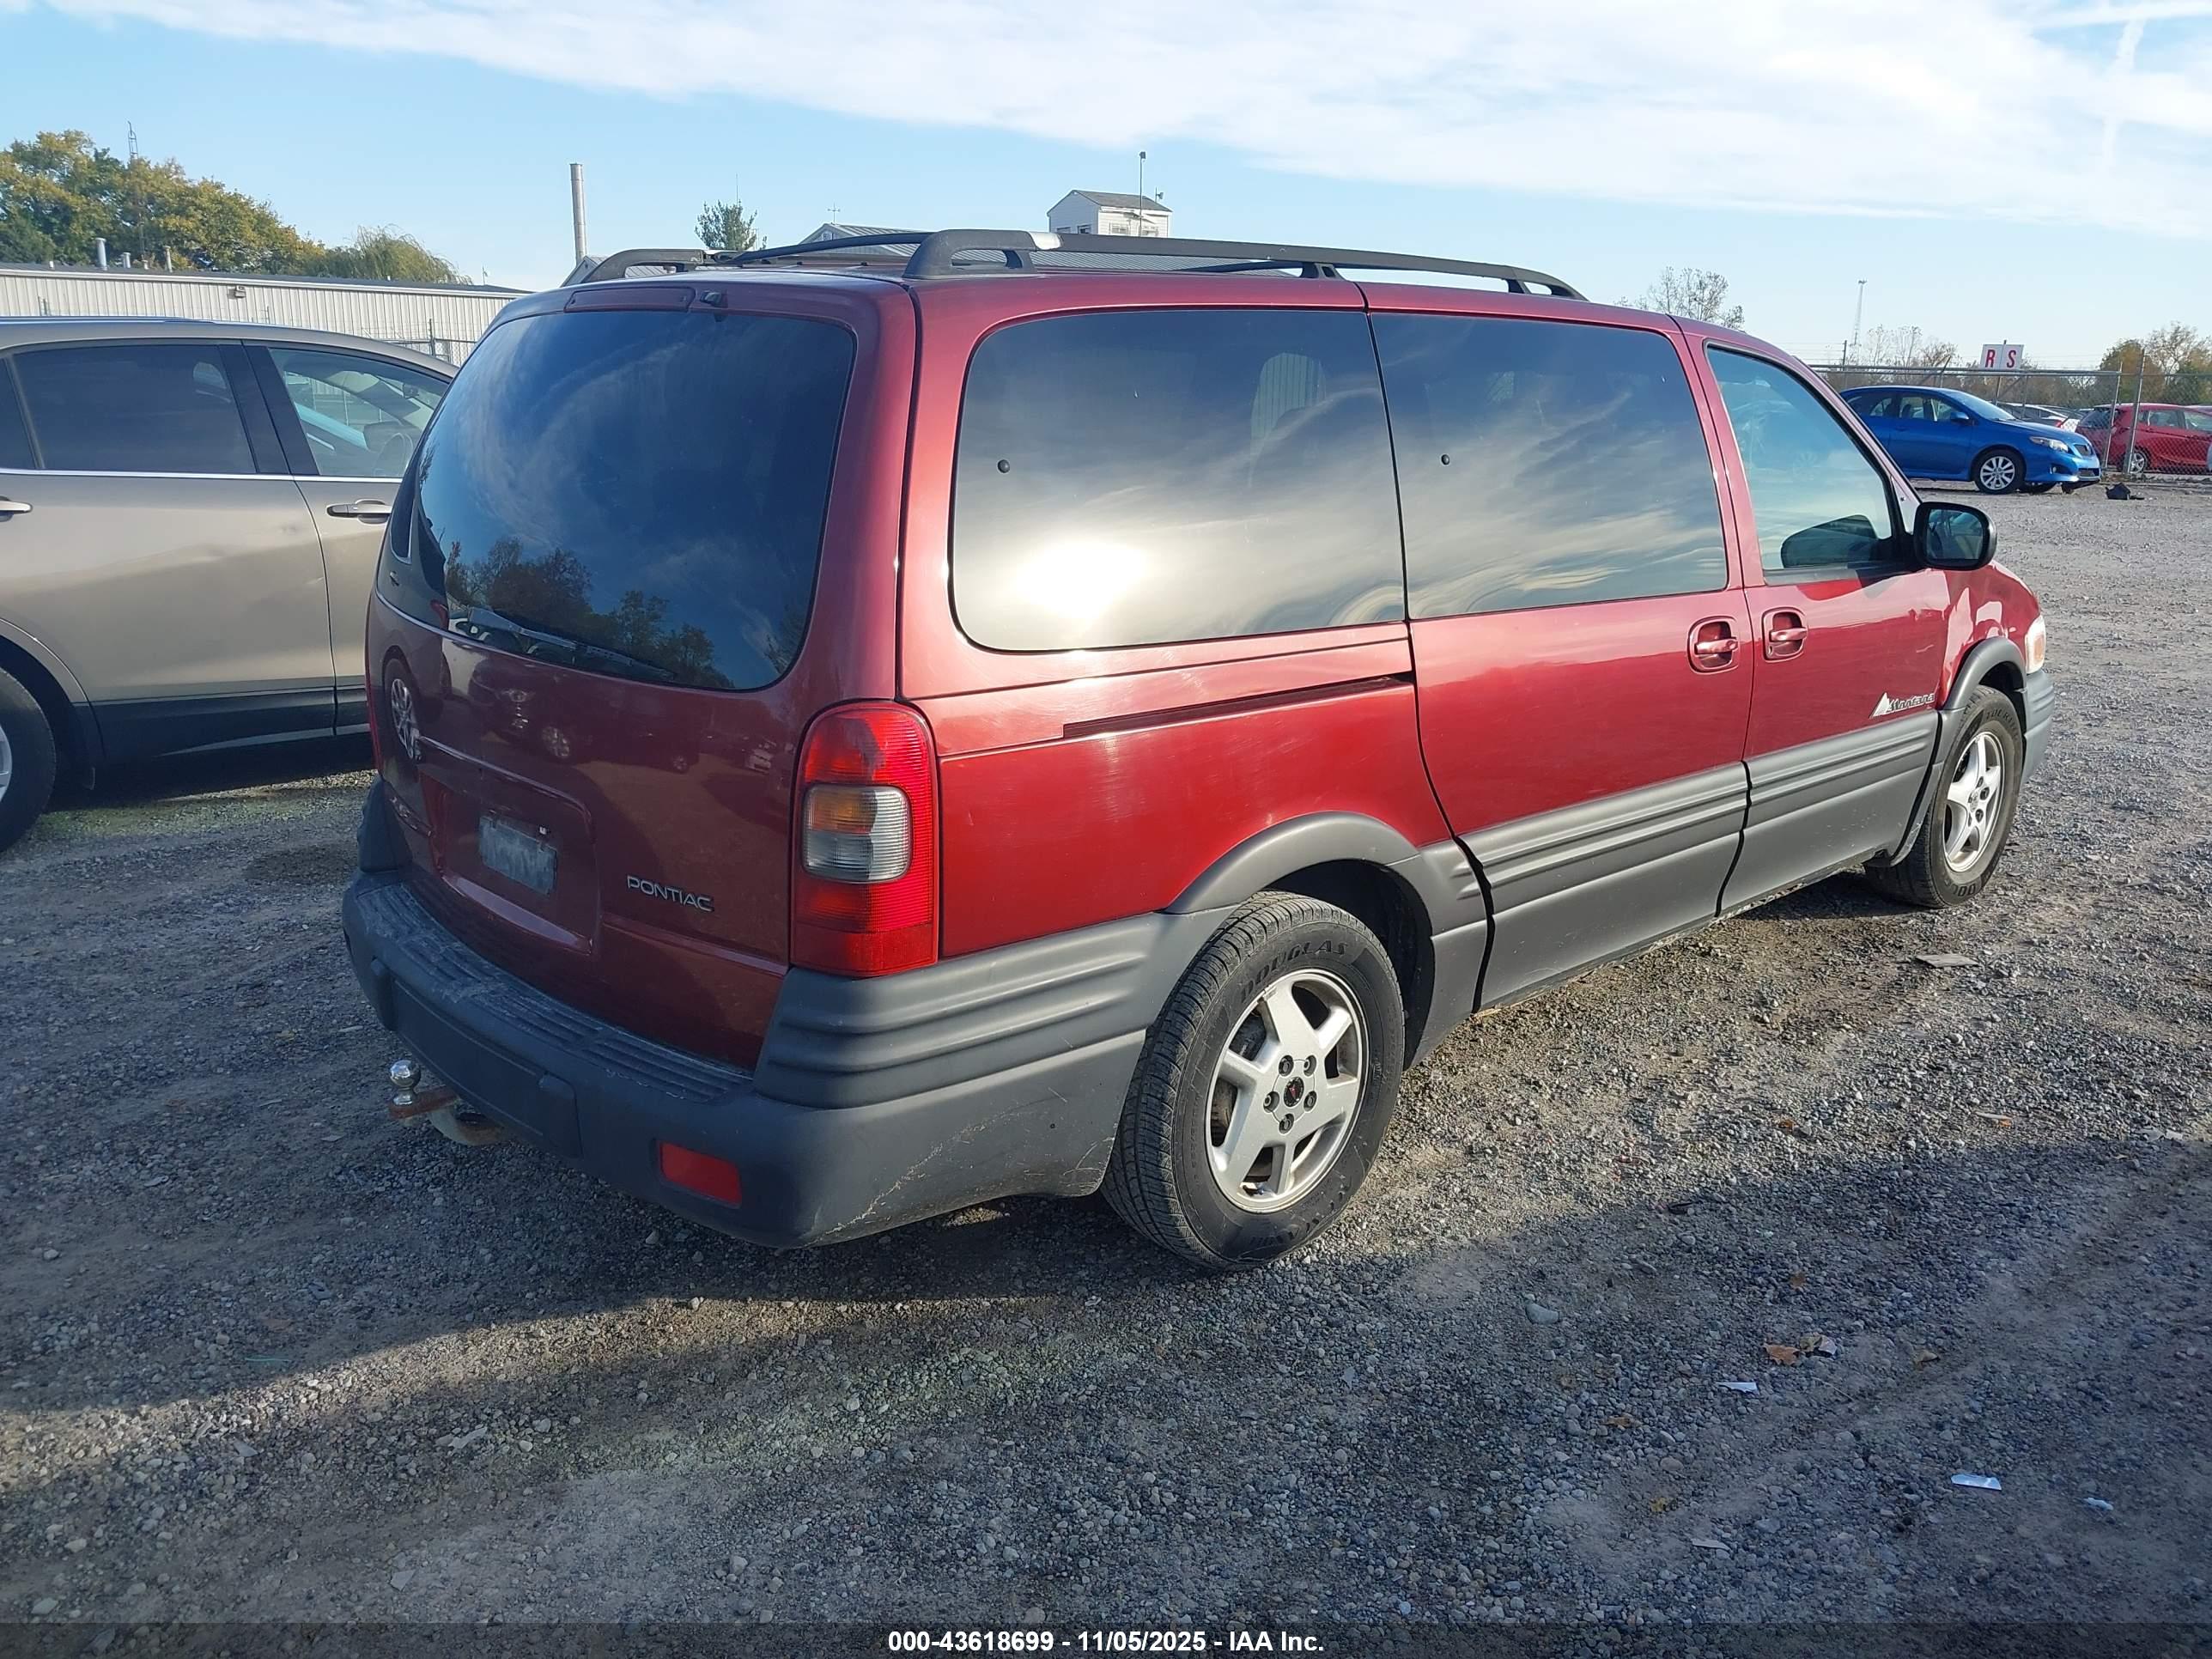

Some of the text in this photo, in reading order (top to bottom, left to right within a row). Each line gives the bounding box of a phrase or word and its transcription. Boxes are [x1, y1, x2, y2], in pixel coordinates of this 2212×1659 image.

[1984, 349, 2017, 368] R S
[627, 875, 713, 912] PONTIAC
[1240, 939, 1349, 1004] DOUGLAS
